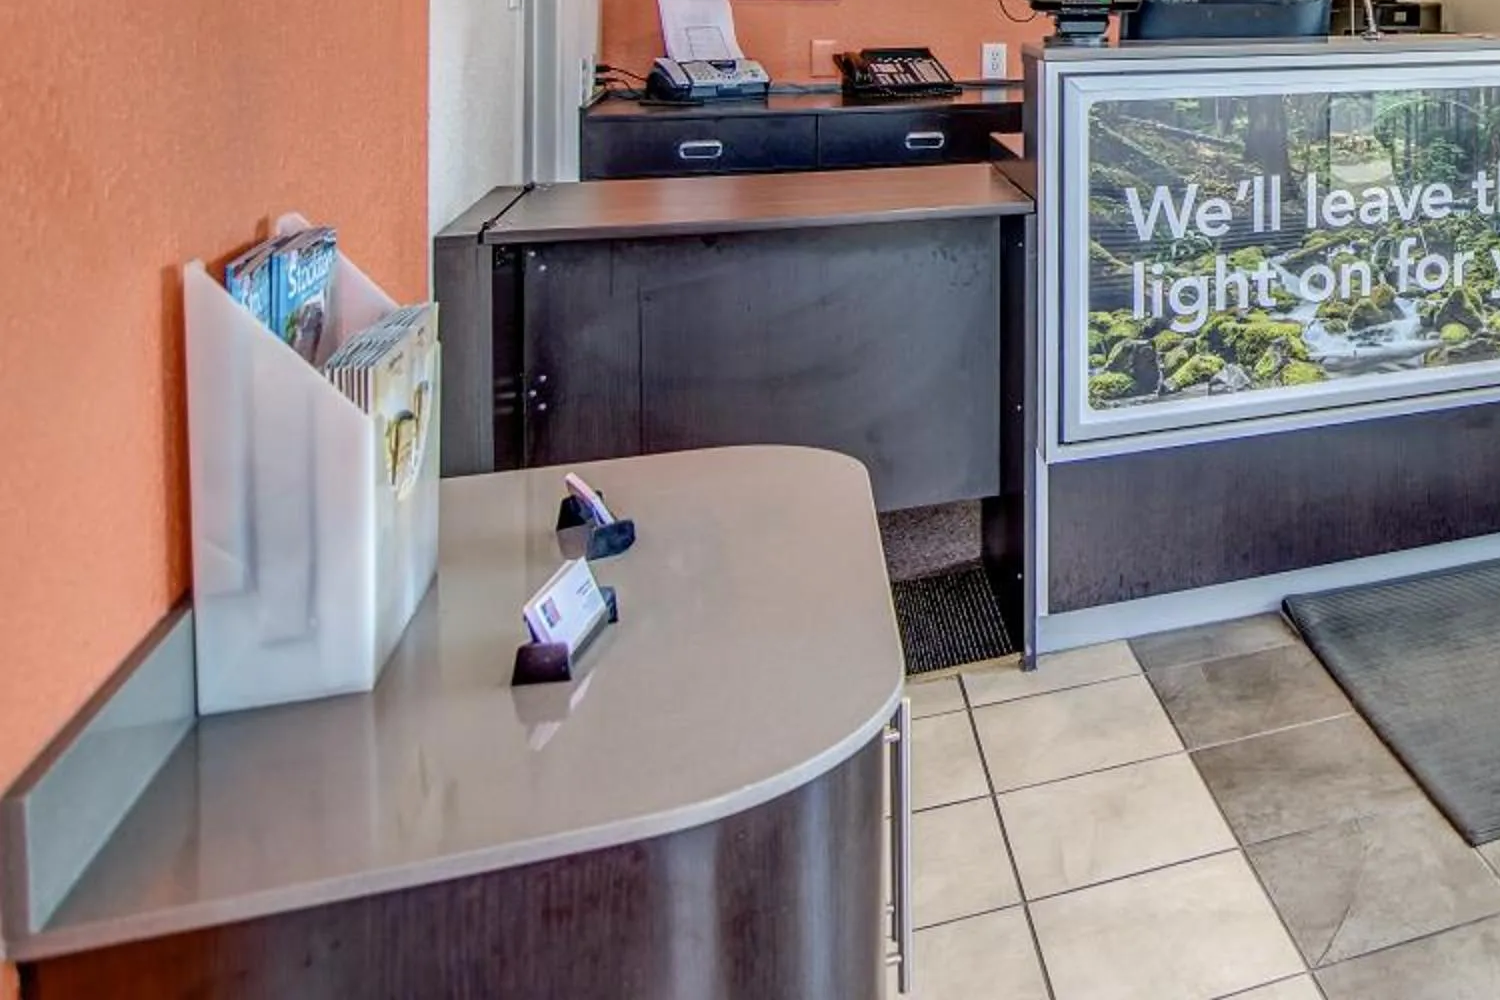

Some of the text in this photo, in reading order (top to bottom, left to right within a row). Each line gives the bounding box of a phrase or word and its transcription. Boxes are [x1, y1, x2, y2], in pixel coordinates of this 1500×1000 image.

[1125, 174, 1282, 241] We'll
[1306, 171, 1454, 229] leave
[1132, 254, 1279, 332] light
[1299, 261, 1371, 303] on
[1397, 237, 1475, 294] for
